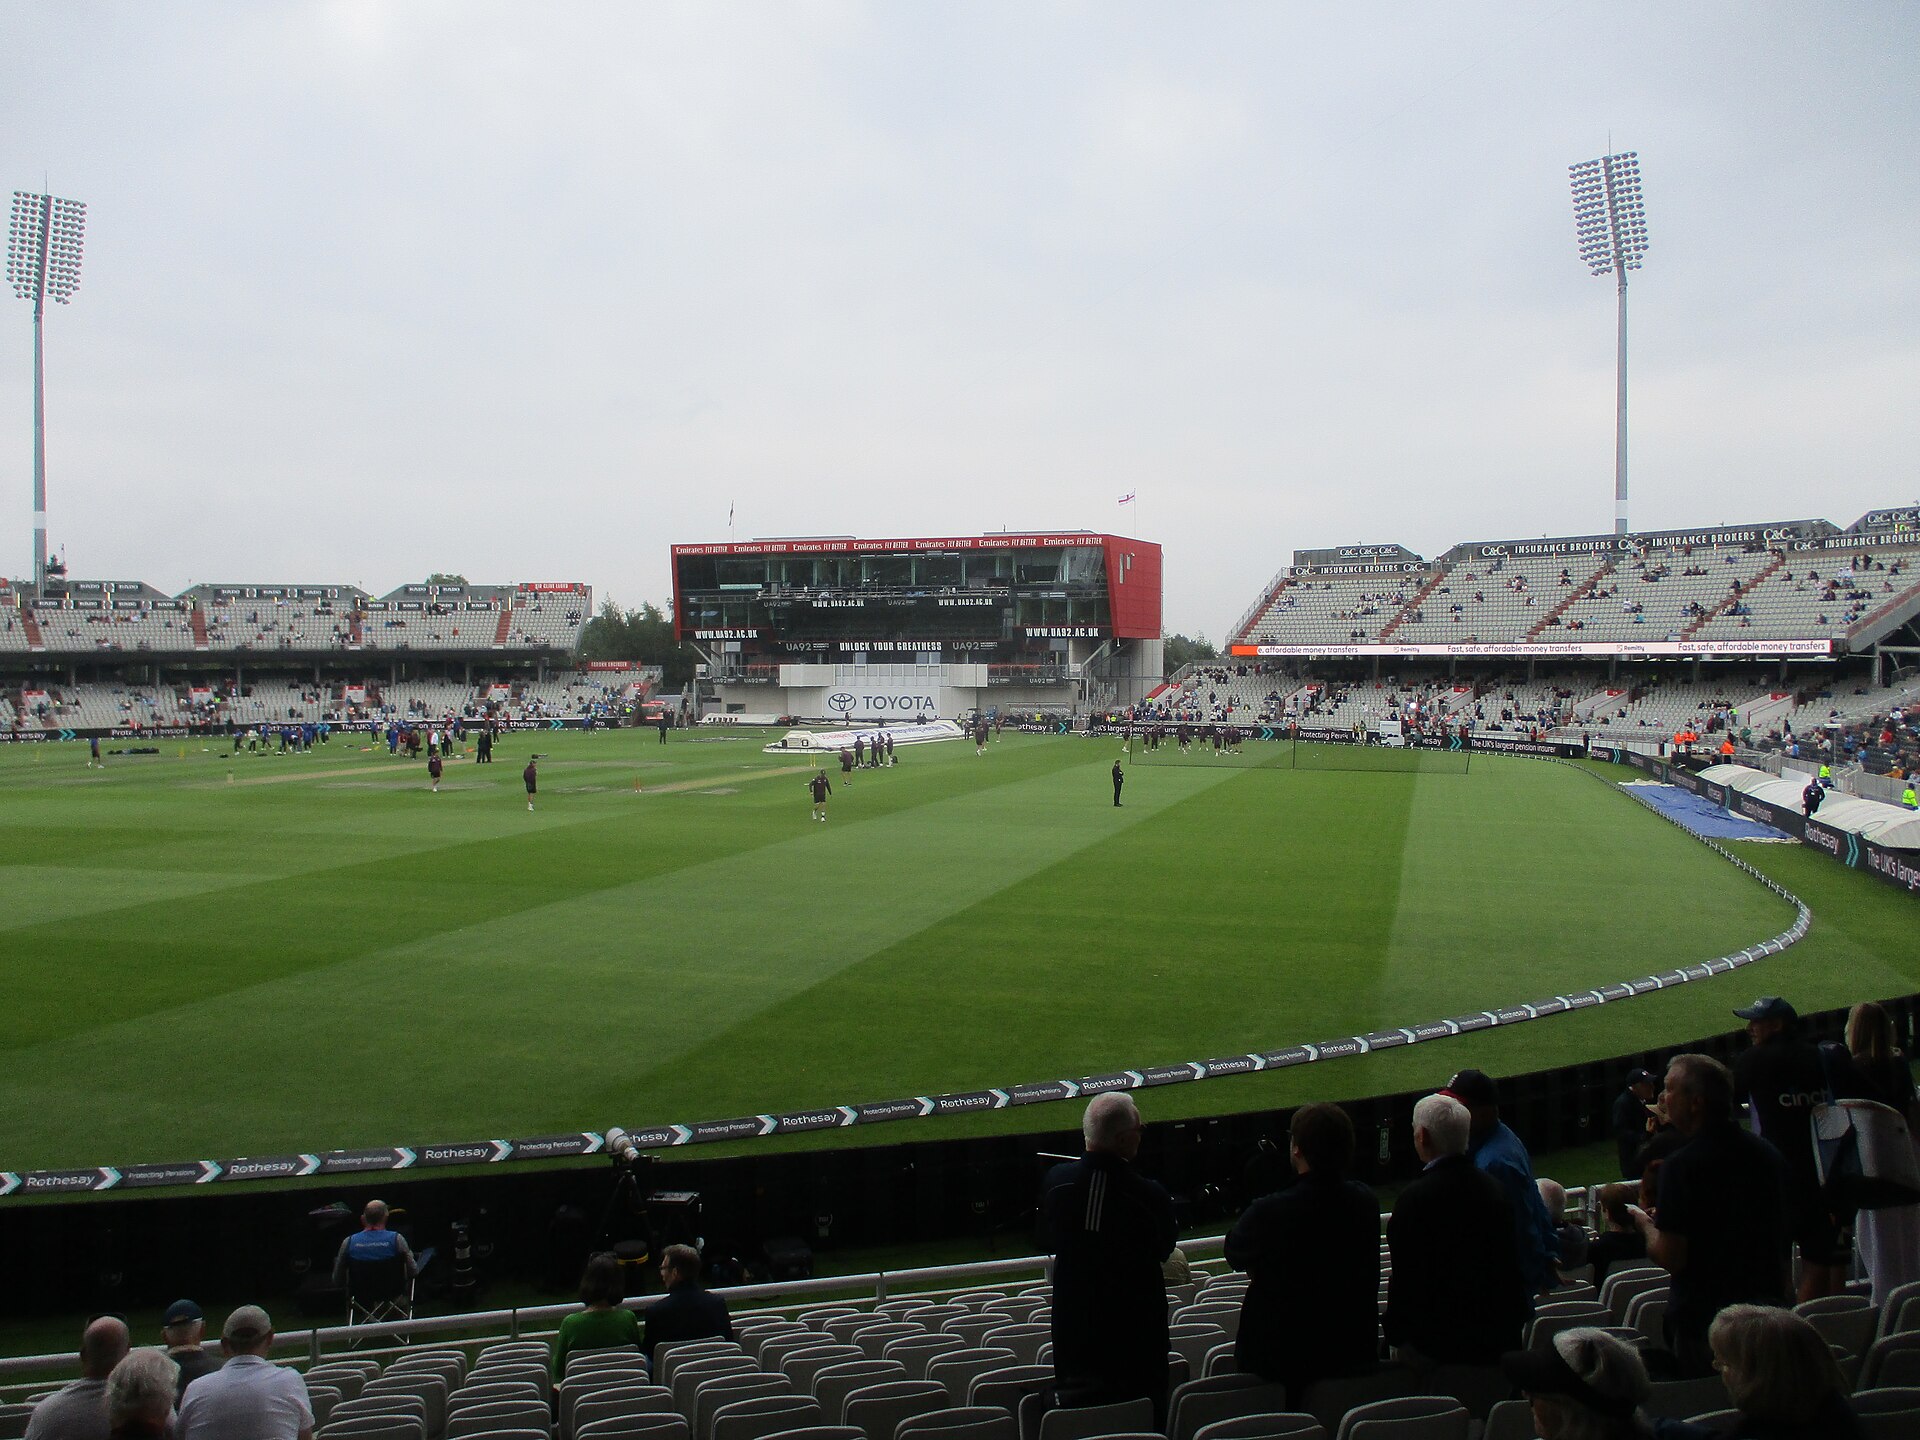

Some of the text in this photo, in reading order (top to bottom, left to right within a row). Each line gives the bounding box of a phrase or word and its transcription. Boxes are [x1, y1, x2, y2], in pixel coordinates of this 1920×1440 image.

[916, 541, 945, 549] Emirates
[979, 539, 1010, 547] Emirates
[1044, 538, 1075, 546] Emirates
[1653, 536, 1706, 546] INSURANCE
[1711, 532, 1755, 543] BROKERS
[1825, 537, 1876, 549] INSURANCE
[1880, 533, 1920, 544] BROKERS
[734, 545, 762, 553] Emirates
[854, 542, 883, 550] Emirates
[1515, 543, 1566, 554] INSURANCE
[1570, 541, 1611, 551] BROKERS
[1365, 564, 1398, 573] BROKERS
[695, 630, 758, 639] WWW.UA92.AC.UK
[1026, 628, 1099, 637] WWW.UA92.AC.UK
[786, 643, 811, 651] UA92
[840, 642, 942, 651] UNLOCK YOUR GREATNESS
[952, 642, 980, 650] UA92
[1549, 644, 1582, 652] transfers
[1678, 642, 1825, 652] Fast, safe, affordable money transfers
[863, 696, 935, 710] TOYOTA
[1299, 731, 1330, 740] Protecting
[1471, 739, 1482, 748] The
[1495, 741, 1514, 751] largest
[1515, 743, 1537, 752] pension
[1805, 822, 1840, 855] Rothesay
[1867, 847, 1880, 869] The
[1320, 1042, 1357, 1055] Rothesay
[1208, 1058, 1250, 1071] Rothesay
[1082, 1076, 1128, 1091] Rothesay
[940, 1095, 991, 1109] Rothesay
[863, 1103, 916, 1116] Protecting Pensions
[782, 1112, 837, 1127] Rothesay
[698, 1122, 756, 1135] Protecting Pensions
[519, 1139, 581, 1151] Protecting Pensions
[425, 1146, 489, 1161] Rothesay
[229, 1161, 296, 1175] Rothesay
[27, 1174, 96, 1188] Rothesay
